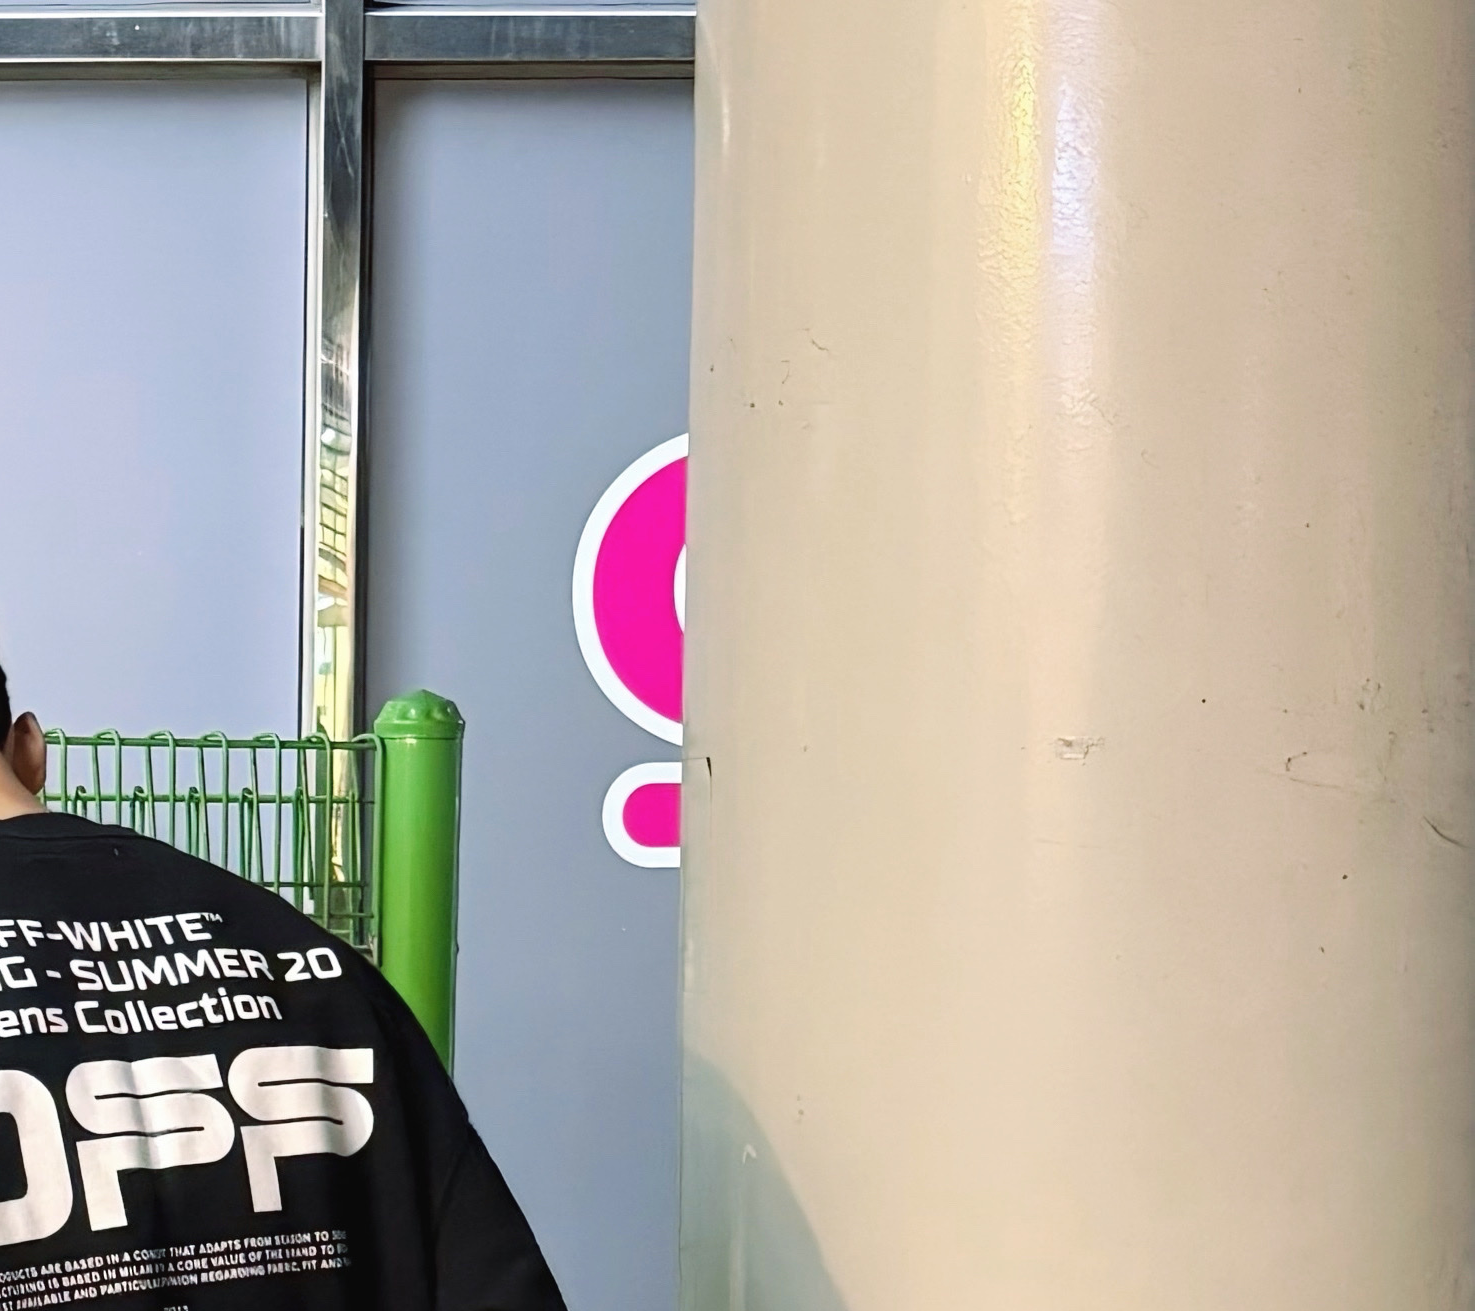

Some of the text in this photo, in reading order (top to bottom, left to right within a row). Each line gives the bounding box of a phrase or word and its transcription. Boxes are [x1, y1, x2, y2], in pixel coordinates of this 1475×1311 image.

[69, 947, 275, 993] SUMMER
[276, 946, 343, 982] 20
[73, 986, 283, 1035] Collection
[40, 1262, 63, 1275] ARE
[64, 1256, 104, 1273] BASED
[106, 1253, 120, 1265] IN
[121, 1251, 131, 1263] A
[169, 1244, 196, 1257] THAT
[199, 1239, 242, 1255] ADAPTS
[243, 1235, 272, 1249] FROM
[314, 1230, 330, 1242] TO
[62, 1270, 101, 1288] BASED
[103, 1267, 117, 1281] IN
[167, 1261, 175, 1272] A
[176, 1256, 209, 1271] CORE
[210, 1251, 246, 1267] VALUE
[248, 1250, 263, 1263] OF
[265, 1248, 283, 1261] THE
[320, 1243, 335, 1255] TO
[74, 1284, 98, 1300] AND
[200, 1264, 266, 1283] REGARDING
